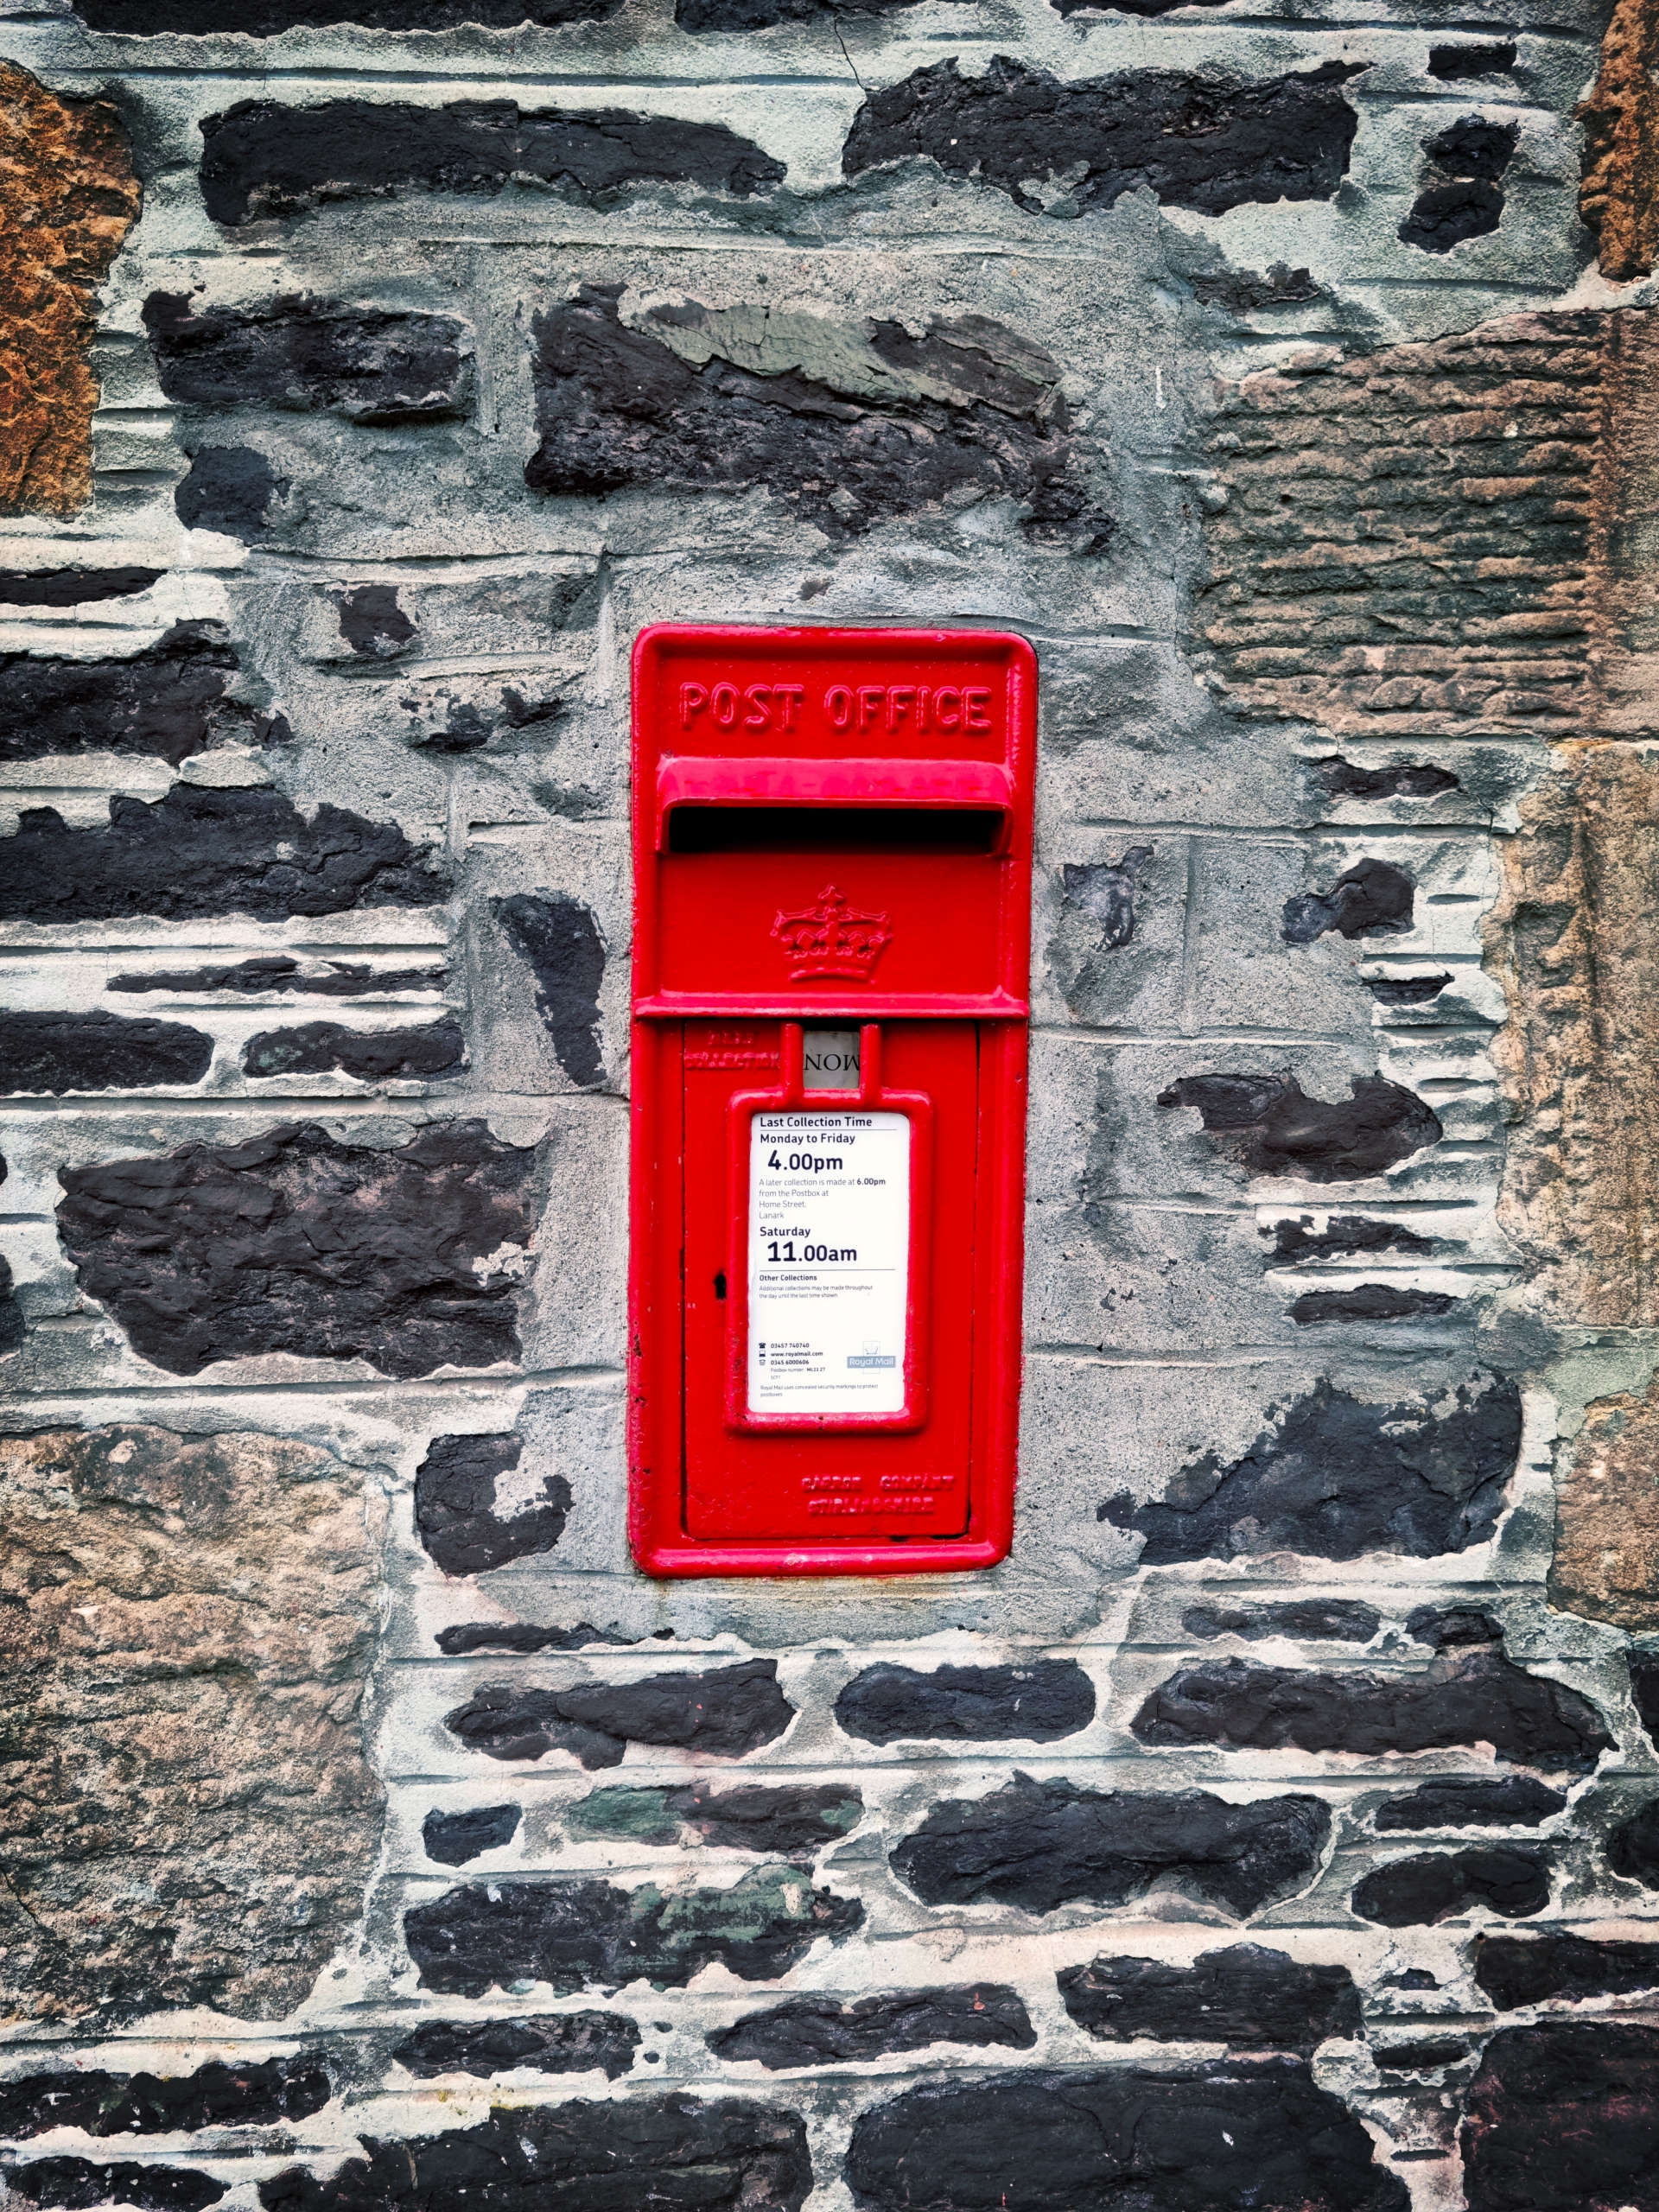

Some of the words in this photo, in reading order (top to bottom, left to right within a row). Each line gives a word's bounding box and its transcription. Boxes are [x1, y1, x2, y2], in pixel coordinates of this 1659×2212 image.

[679, 682, 804, 731] POST
[824, 685, 993, 734] OFFICE
[760, 1116, 784, 1127] Last
[786, 1116, 841, 1127] Collection
[844, 1116, 872, 1126] Time
[760, 1134, 804, 1145] Monday
[806, 1135, 817, 1143] to
[821, 1133, 855, 1145] Friday
[768, 1150, 842, 1173] 4.00pm
[857, 1178, 886, 1186] 6.00pm
[760, 1227, 810, 1238] Saturday
[767, 1241, 856, 1262] 11.00am
[850, 1358, 873, 1367] Royal
